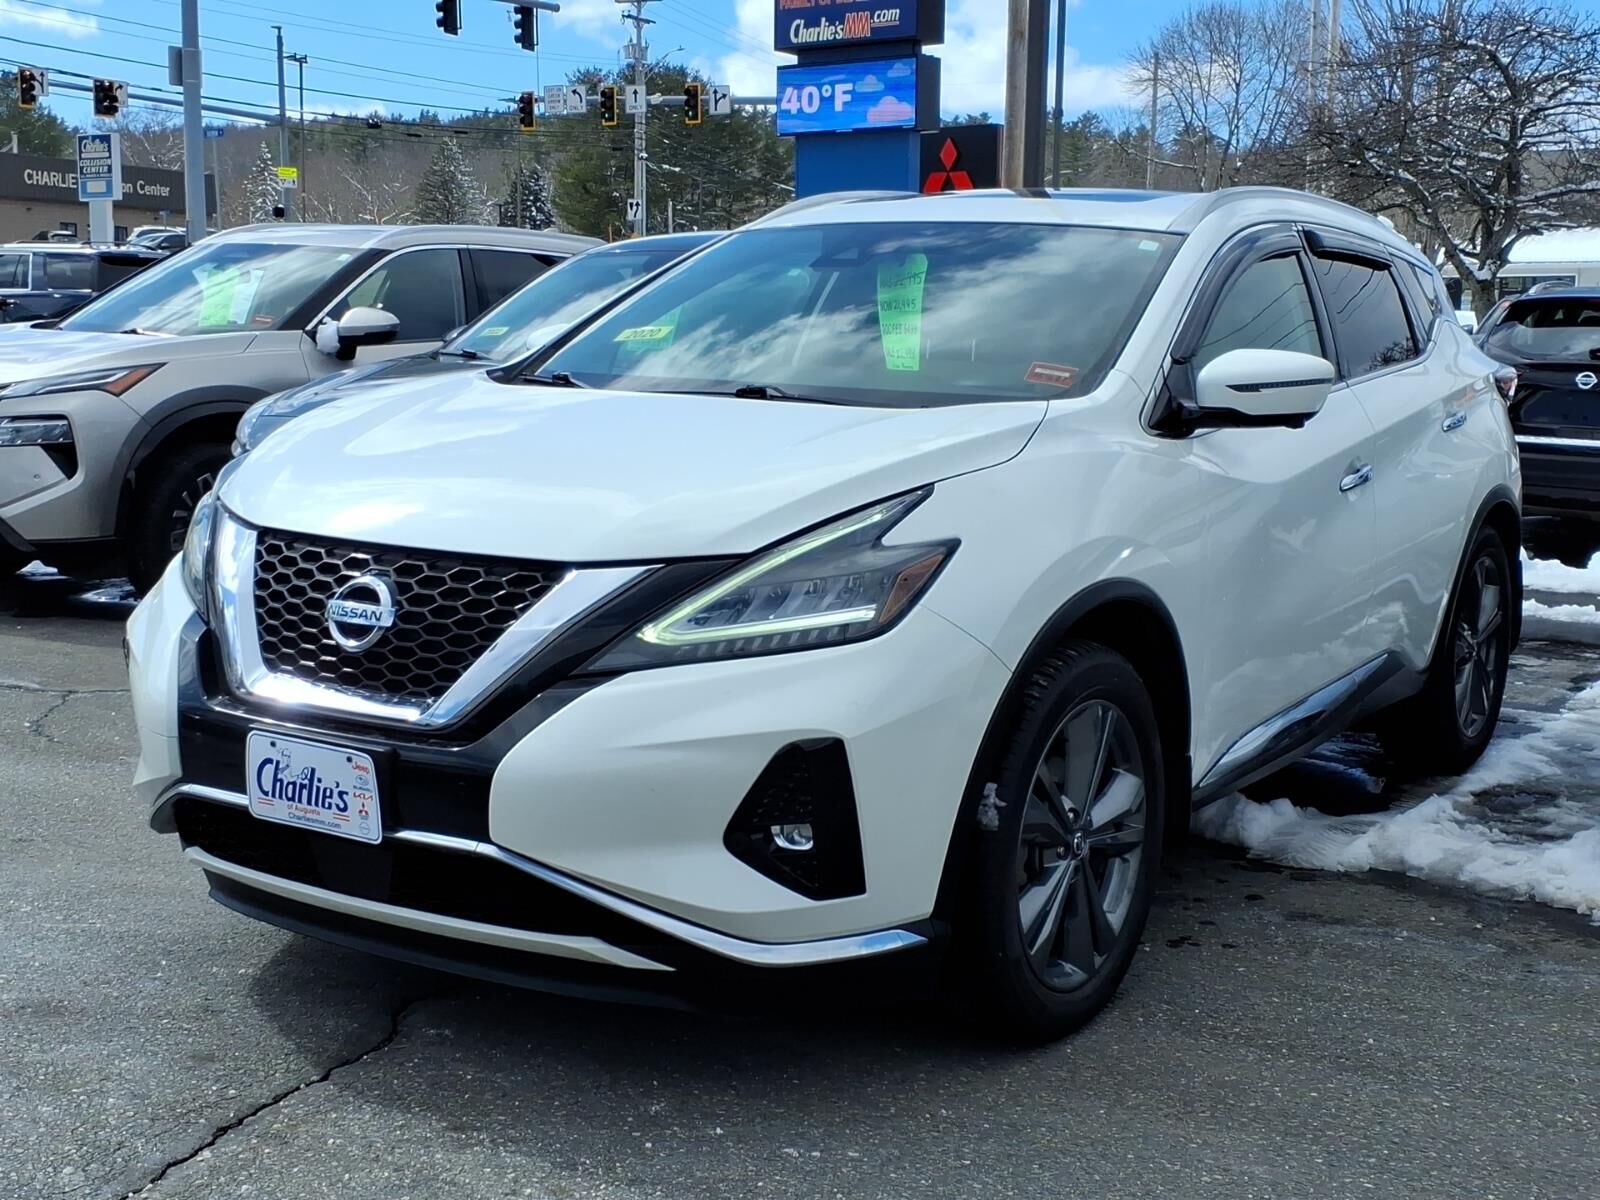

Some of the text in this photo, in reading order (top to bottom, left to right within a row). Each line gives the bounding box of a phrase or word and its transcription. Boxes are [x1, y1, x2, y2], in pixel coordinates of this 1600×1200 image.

[780, 83, 853, 115] 40°F
[79, 159, 112, 167] COLLISION
[83, 166, 108, 174] CENTER
[136, 180, 171, 197] Center
[623, 327, 663, 339] 2020
[328, 605, 383, 622] NISSAN
[256, 757, 349, 813] Charlie's
[294, 804, 321, 816] Augusta
